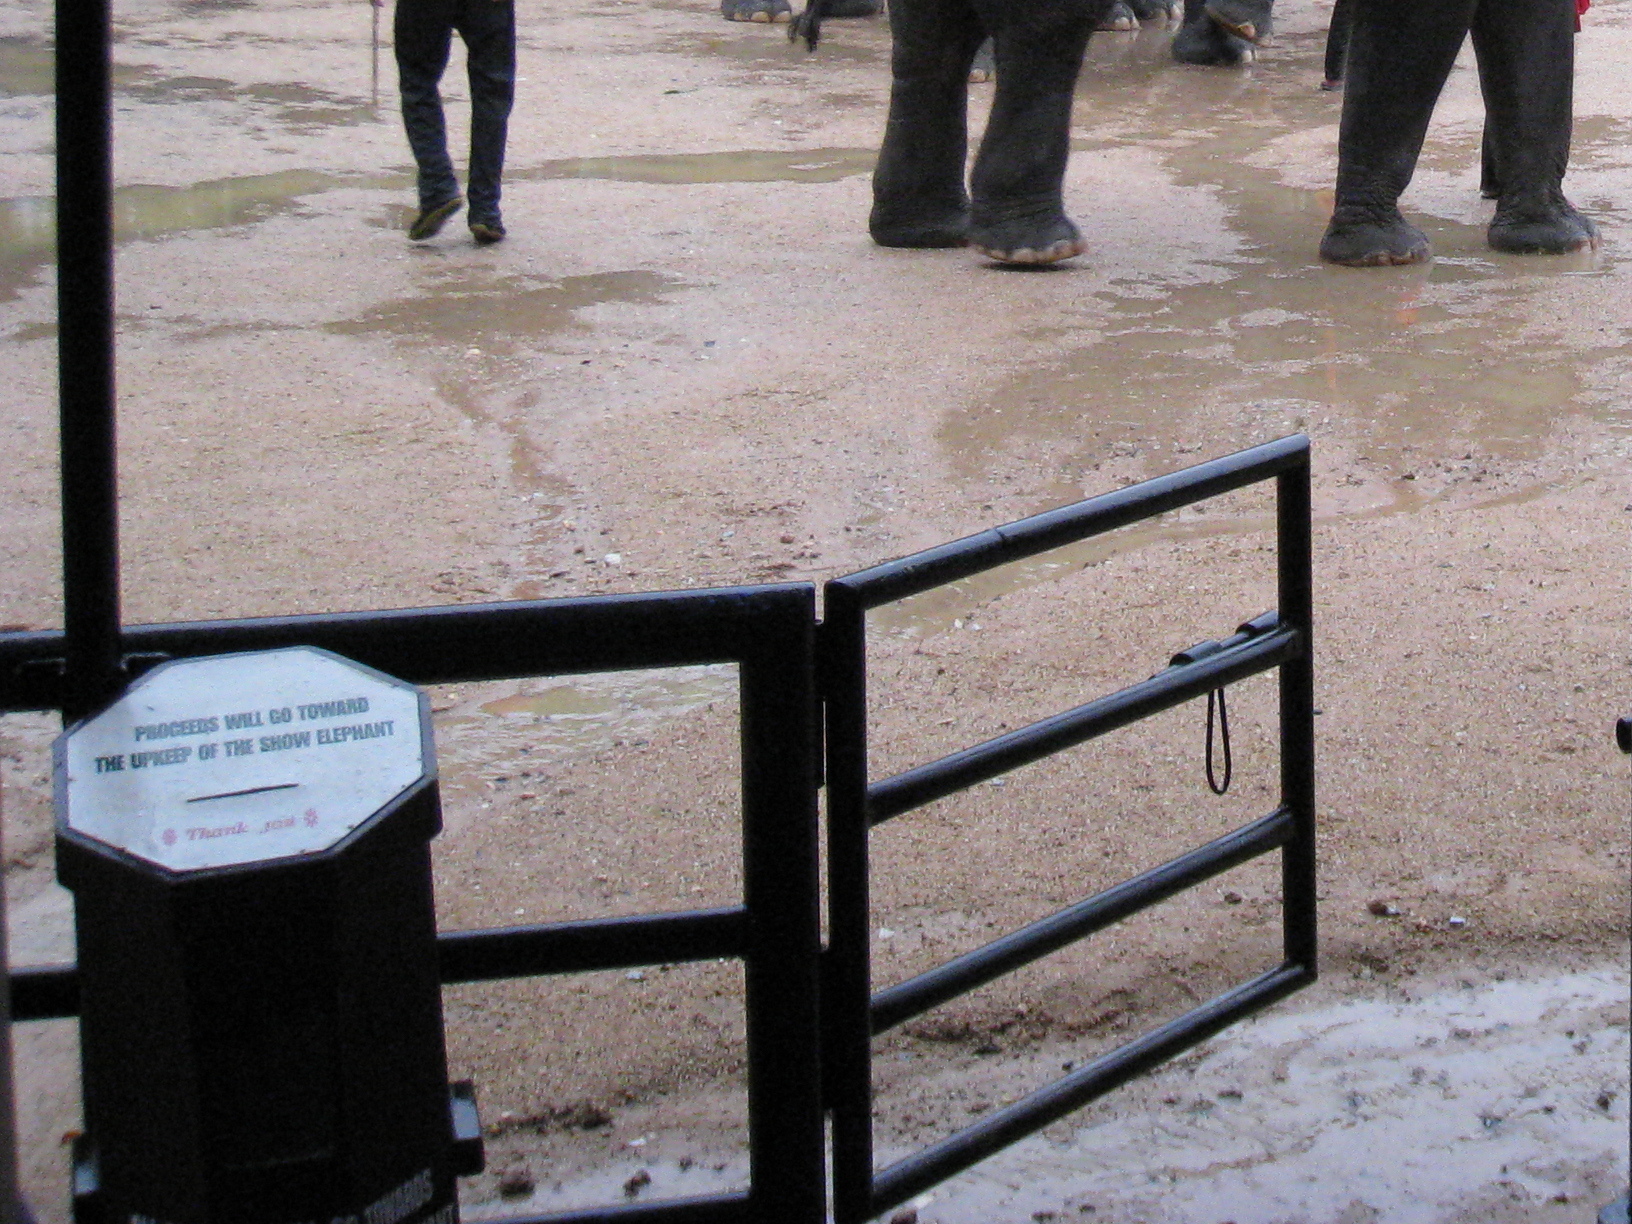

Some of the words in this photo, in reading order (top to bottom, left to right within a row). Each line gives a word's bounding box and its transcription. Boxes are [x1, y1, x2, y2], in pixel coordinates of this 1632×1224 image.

[134, 716, 220, 742] PROCEEDS
[224, 710, 263, 730] WILL
[268, 706, 292, 725] GO
[298, 697, 369, 721] TOWARD
[94, 755, 124, 774] THE
[130, 746, 192, 769] UPKEEP
[198, 742, 217, 761] OF
[224, 738, 254, 757] THE
[260, 731, 311, 752] SHOW
[317, 721, 394, 745] ELEPHANT
